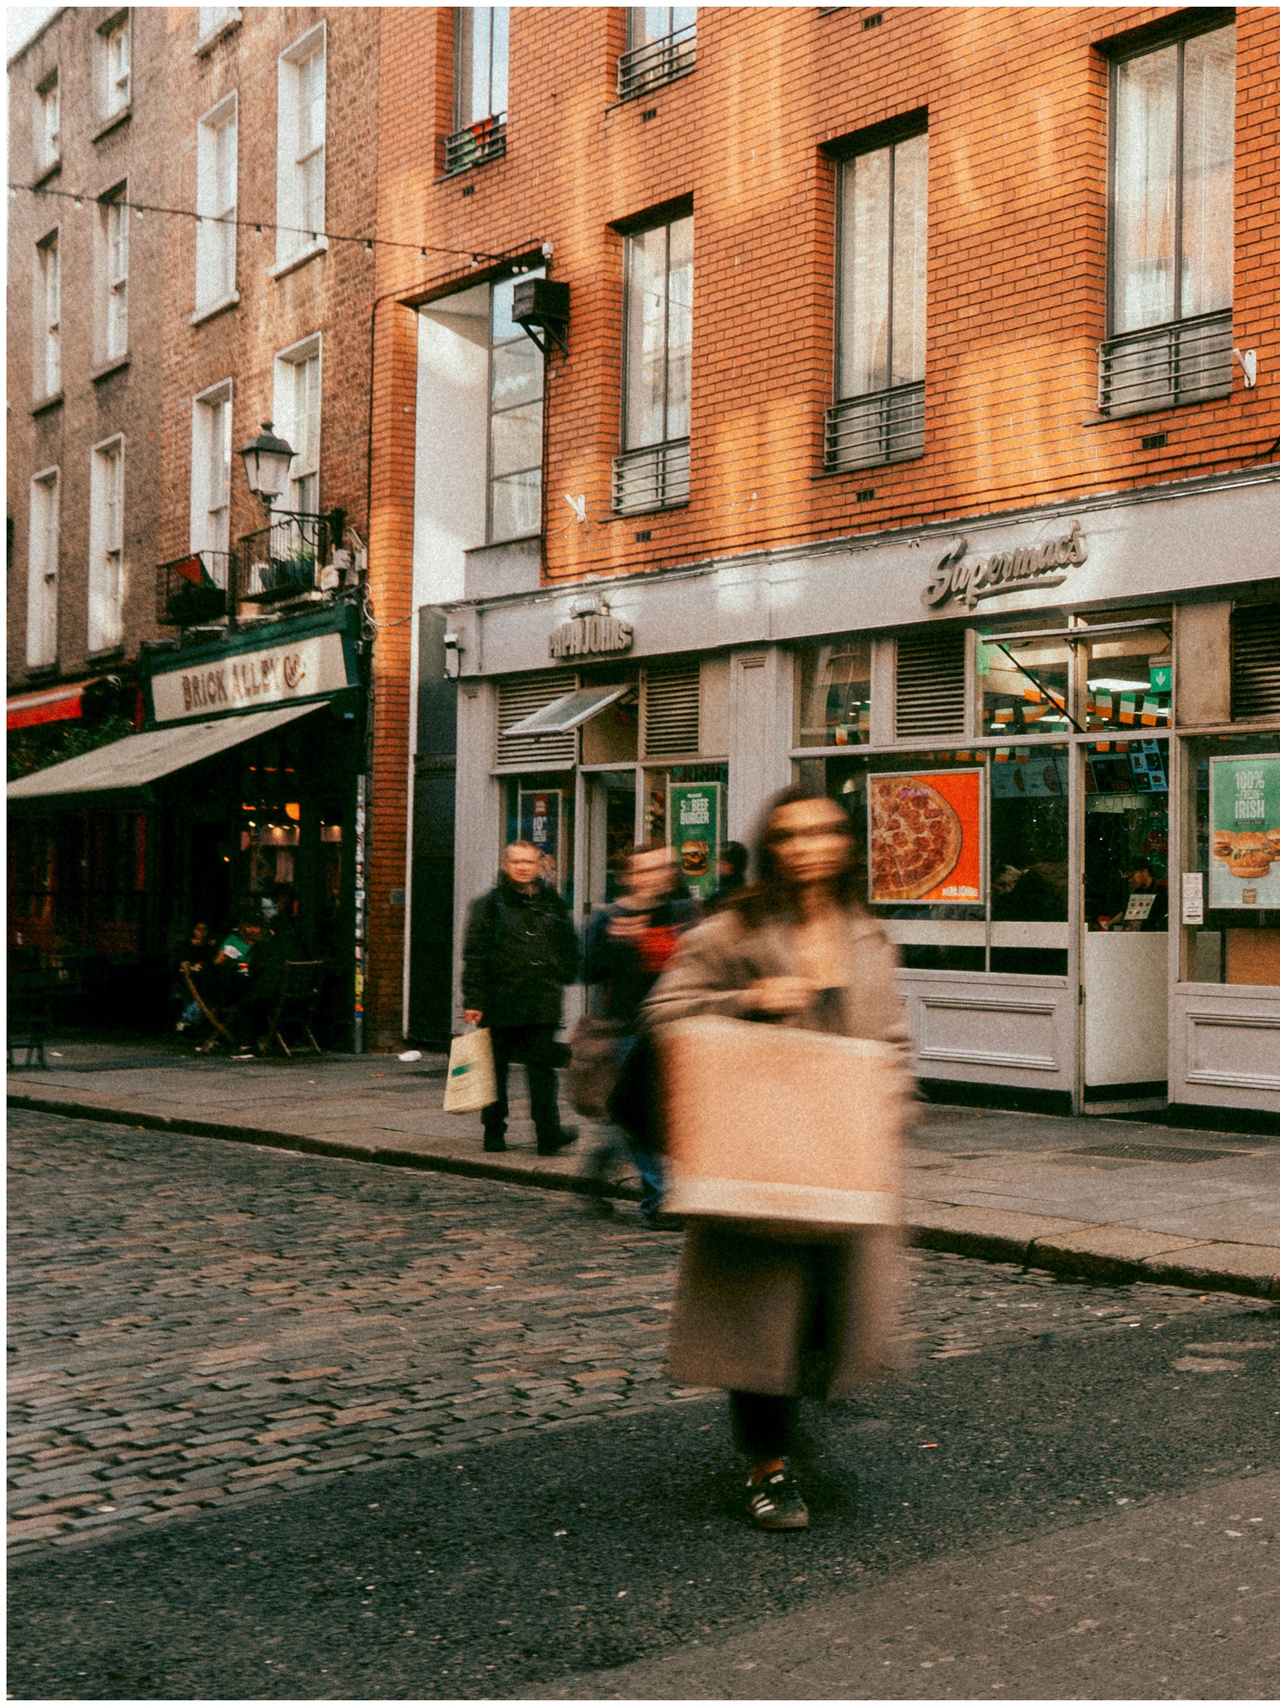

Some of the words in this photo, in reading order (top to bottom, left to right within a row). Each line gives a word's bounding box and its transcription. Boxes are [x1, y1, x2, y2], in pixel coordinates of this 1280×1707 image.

[919, 519, 1089, 612] Supermac's
[182, 668, 229, 711] BRICK
[231, 656, 281, 700] ALLEY
[1235, 771, 1265, 790] 100%
[1235, 800, 1266, 819] IRISH
